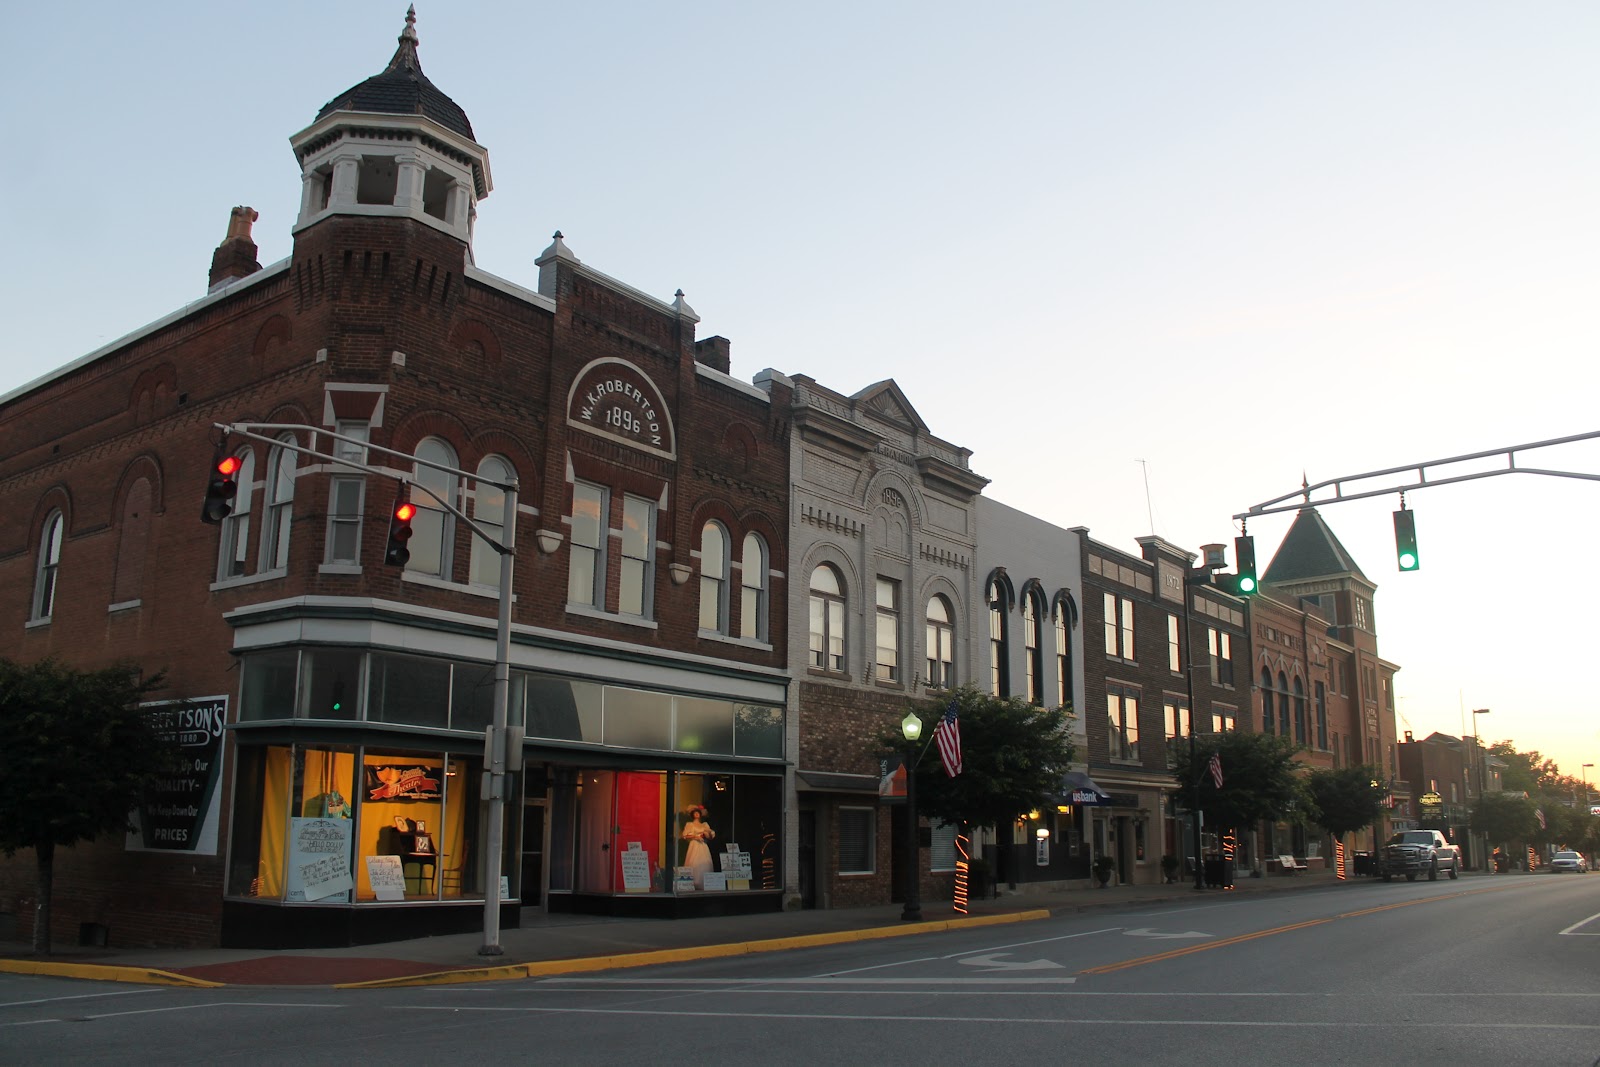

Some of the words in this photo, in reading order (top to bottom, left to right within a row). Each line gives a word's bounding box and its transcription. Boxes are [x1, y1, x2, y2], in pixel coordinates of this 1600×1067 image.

[605, 406, 641, 434] 1896
[180, 733, 198, 743] 1880
[195, 758, 209, 771] Our
[172, 804, 188, 816] Down
[188, 804, 199, 816] Our
[154, 827, 188, 842] PRICES
